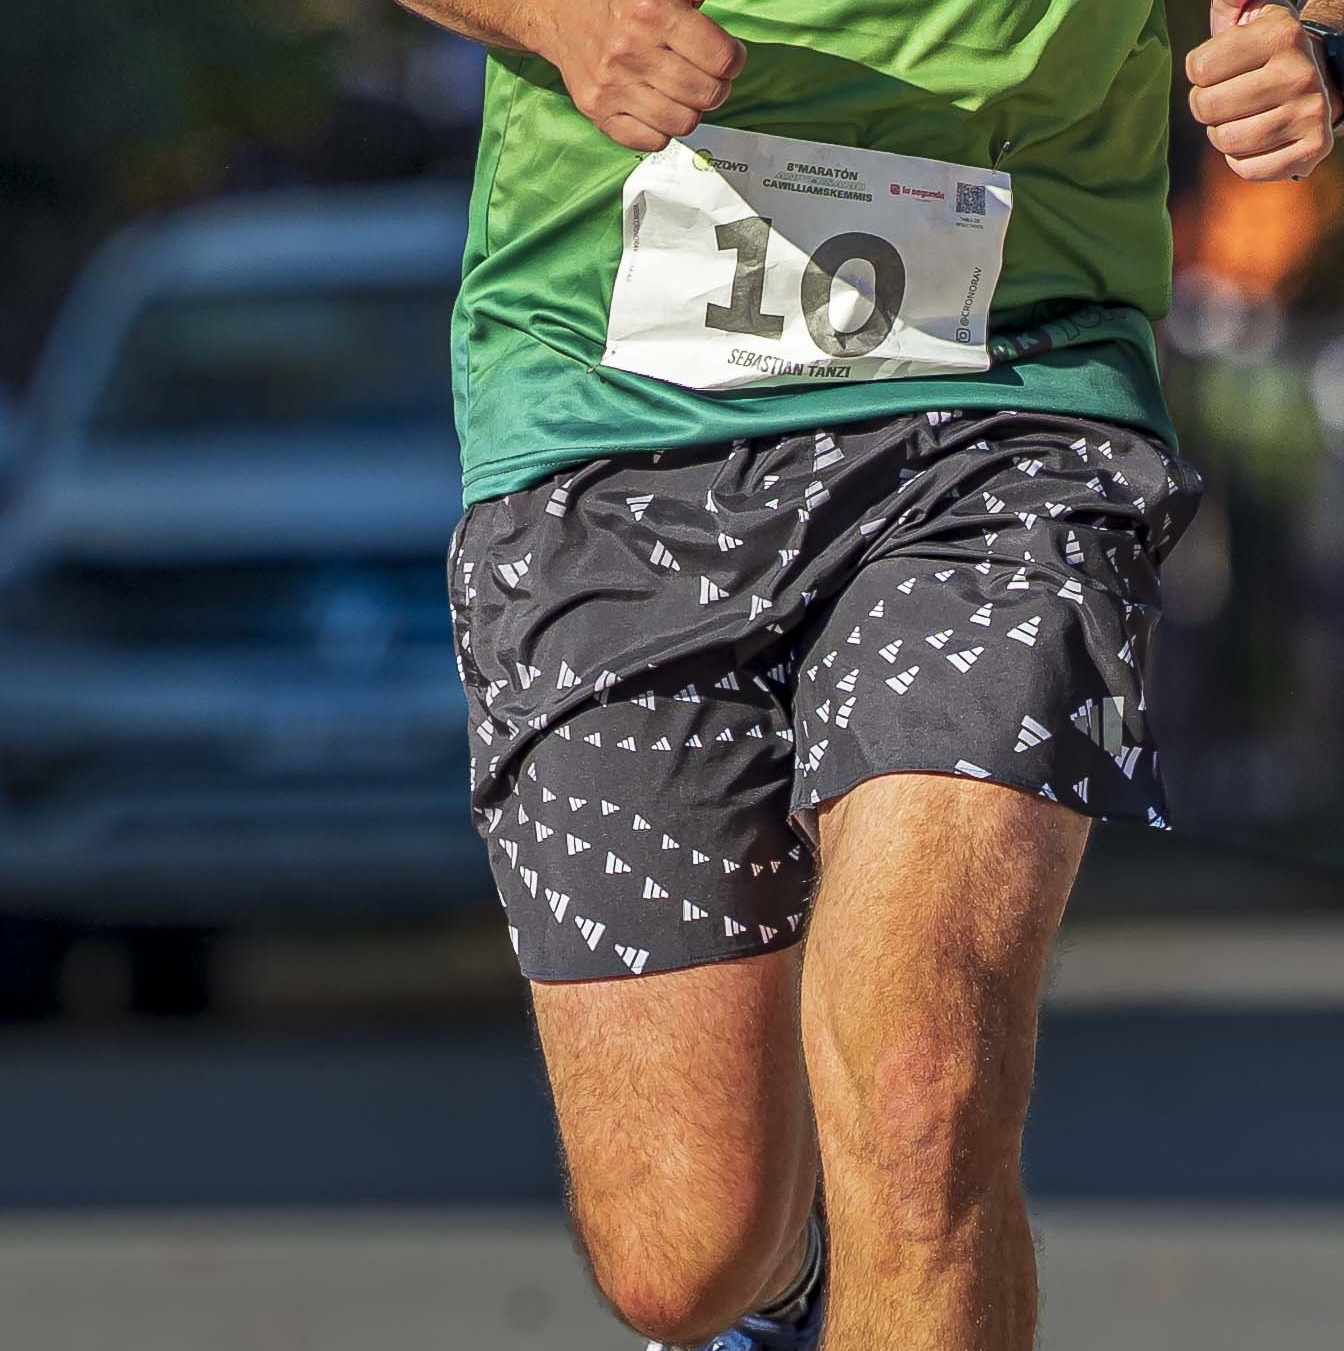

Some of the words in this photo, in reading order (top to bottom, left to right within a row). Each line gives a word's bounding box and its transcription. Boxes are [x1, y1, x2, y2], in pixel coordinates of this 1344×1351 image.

[704, 215, 906, 359] 10
[960, 266, 983, 327] @CRONORAV
[727, 348, 804, 376] SEBASTIAN
[807, 365, 851, 379] TANZI
